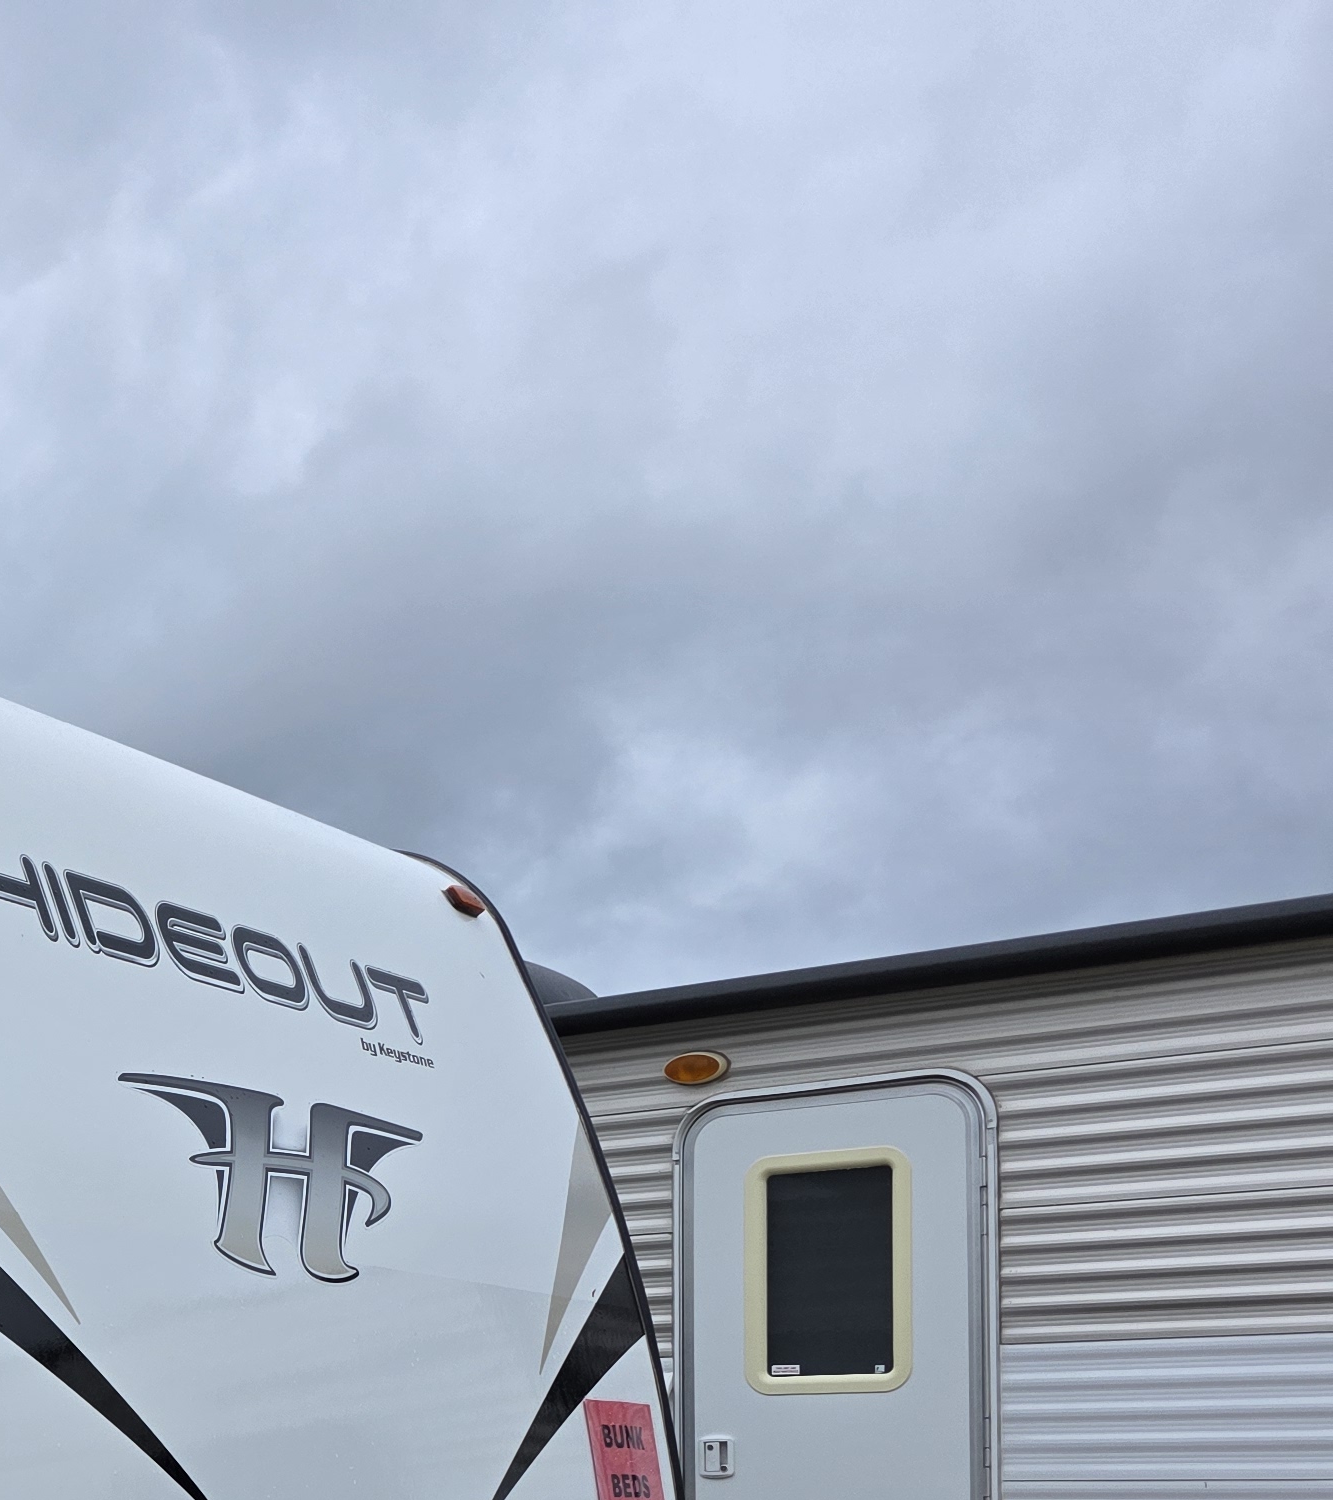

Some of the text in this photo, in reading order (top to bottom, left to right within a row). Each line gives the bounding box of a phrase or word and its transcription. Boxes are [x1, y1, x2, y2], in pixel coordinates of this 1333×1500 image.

[360, 1037, 435, 1069] by Keystone
[601, 1424, 645, 1450] BUNK
[611, 1474, 651, 1498] BEDS
